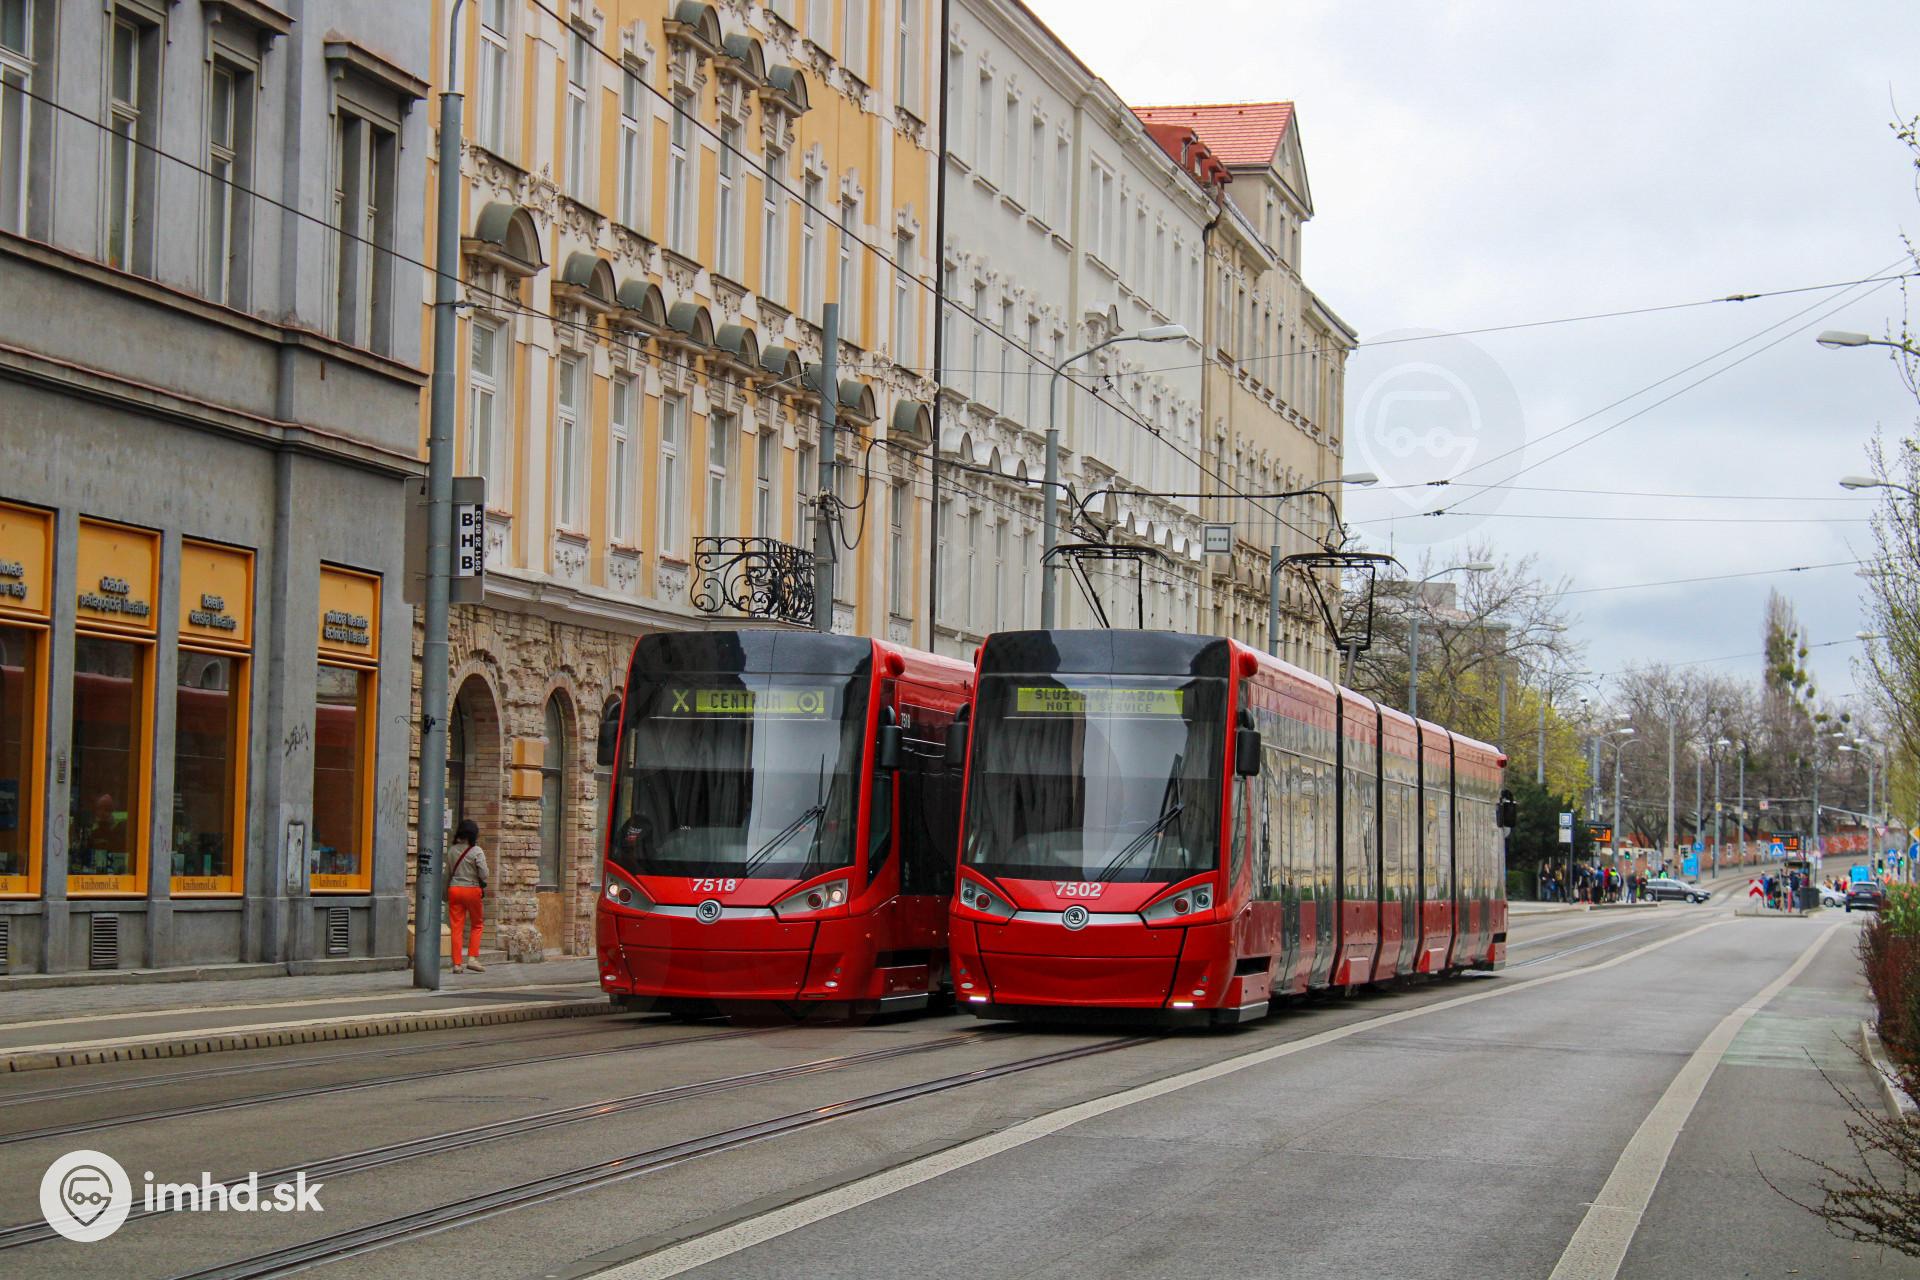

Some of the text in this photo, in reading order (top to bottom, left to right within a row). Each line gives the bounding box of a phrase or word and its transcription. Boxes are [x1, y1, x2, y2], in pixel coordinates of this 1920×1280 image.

[672, 689, 689, 712] X
[1046, 701, 1073, 711] NOT
[693, 878, 737, 892] 7518
[1055, 881, 1102, 897] 7502
